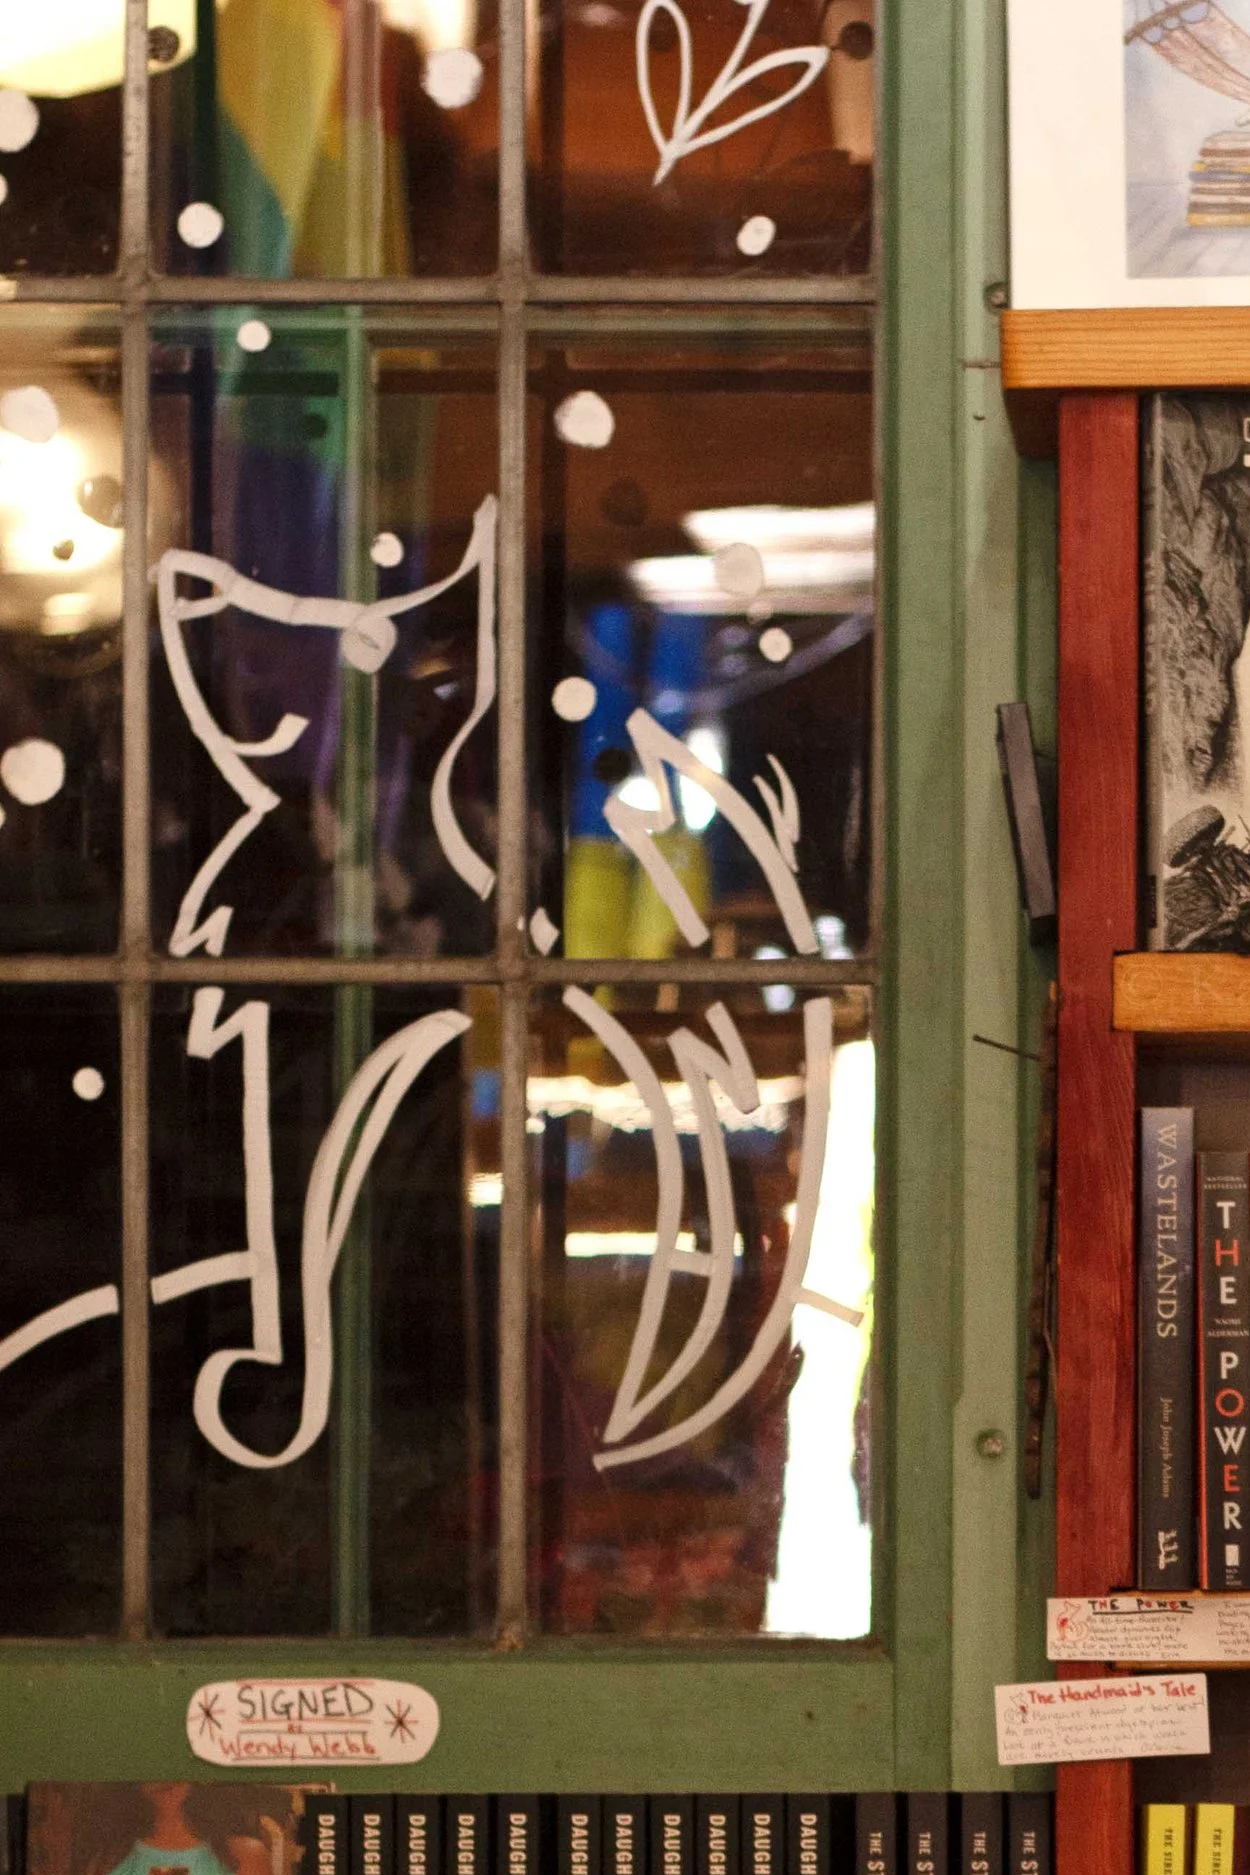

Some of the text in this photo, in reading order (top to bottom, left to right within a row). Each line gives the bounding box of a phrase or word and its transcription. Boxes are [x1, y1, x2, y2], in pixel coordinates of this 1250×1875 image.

[1156, 1124, 1178, 1338] WASTELANDS
[1214, 1201, 1240, 1304] THE
[1214, 1352, 1246, 1530] POWER
[1088, 1600, 1119, 1610] THE
[237, 1683, 375, 1721] SIGNED
[1026, 1681, 1196, 1704] The Handmaid's Tale
[218, 1731, 377, 1761] Wendy Webb
[869, 1832, 882, 1854] THE
[1163, 1828, 1173, 1848] THE
